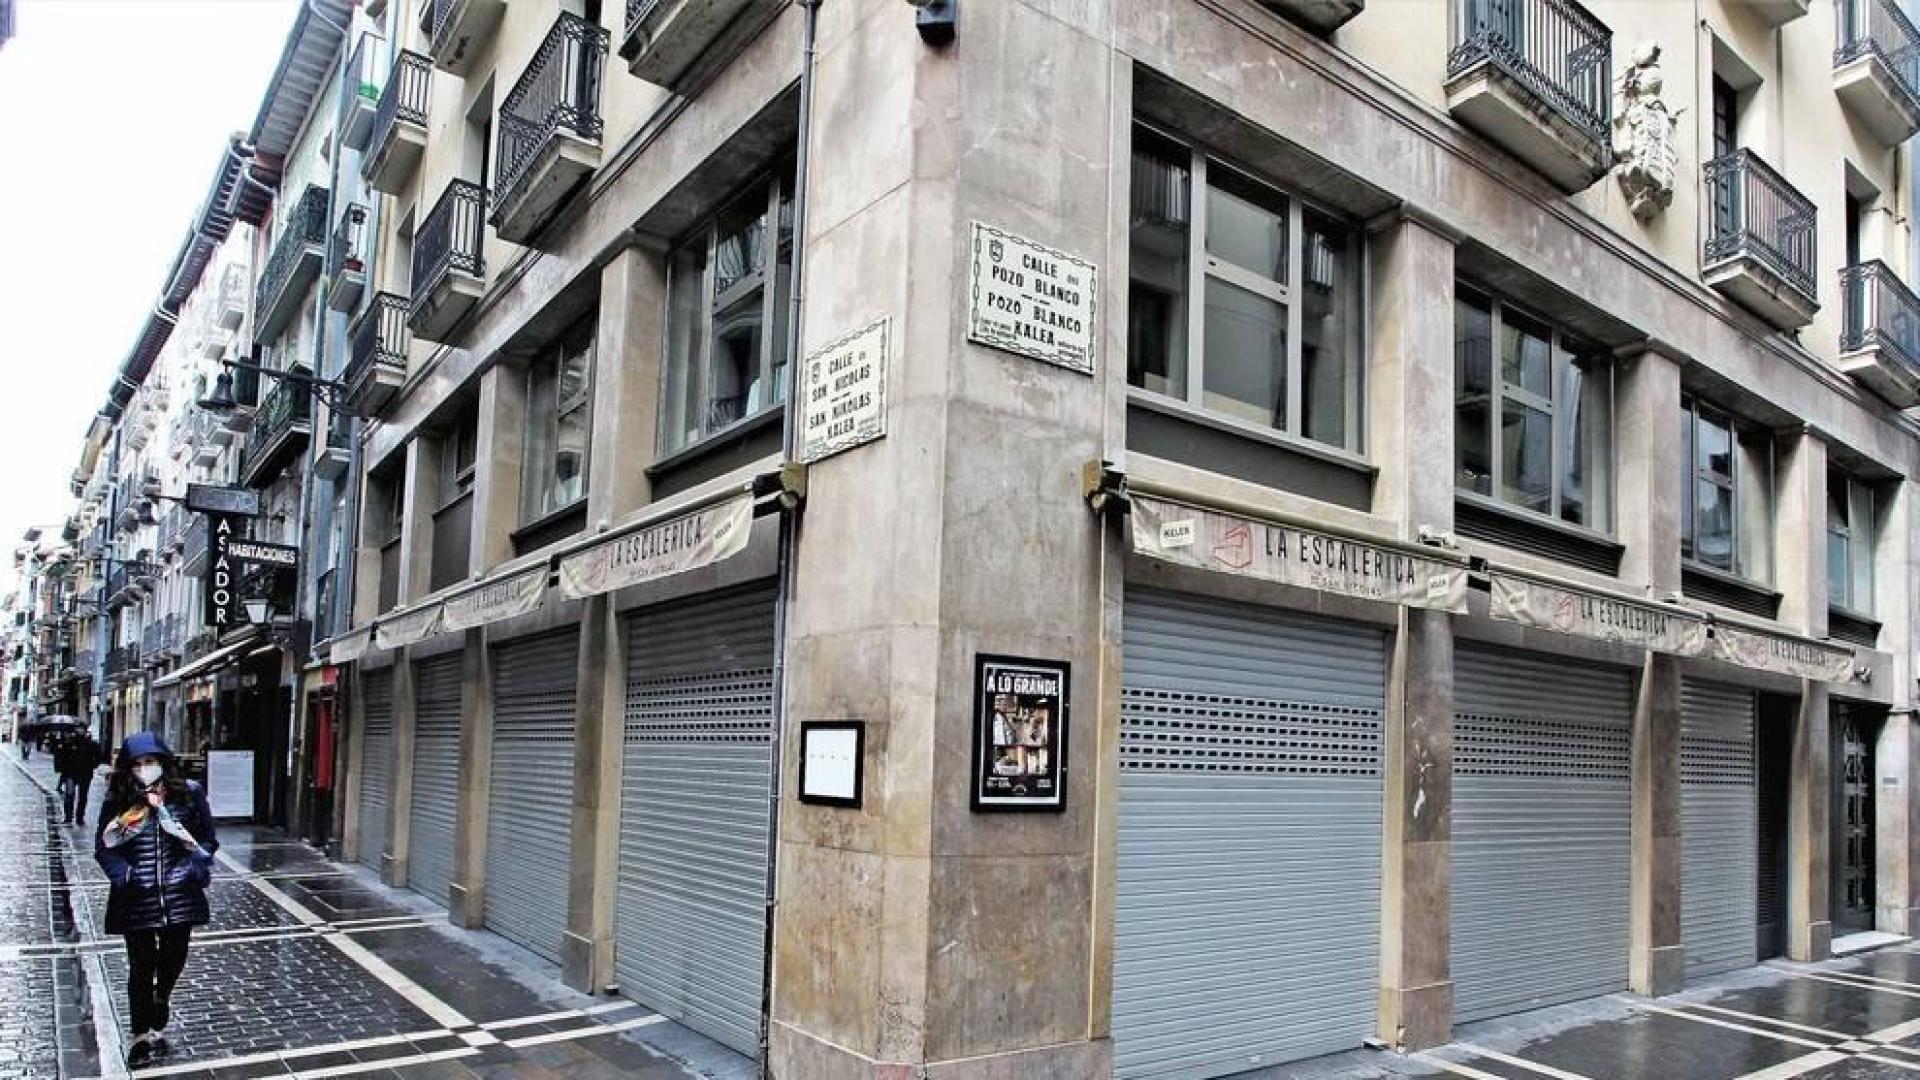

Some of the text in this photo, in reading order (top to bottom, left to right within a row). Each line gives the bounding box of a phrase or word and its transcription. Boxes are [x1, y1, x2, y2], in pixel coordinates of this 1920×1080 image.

[1022, 253, 1058, 279] CALLE
[992, 265, 1079, 306] POZO BLANCO
[988, 292, 1021, 315] POZO
[1033, 305, 1081, 334] BLANCO
[1014, 320, 1054, 346] KALEA
[828, 351, 853, 375] CALLE
[812, 383, 827, 402] SAN
[810, 391, 871, 429] SAN NIKOLAS
[827, 416, 854, 440] KALEA
[625, 515, 702, 565] ESCALERICA
[228, 542, 296, 565] HABITACIONES
[1265, 526, 1415, 583] LA ESCALERICA
[213, 517, 232, 624] ASADOR
[987, 676, 1058, 697] A LO GRANDE
